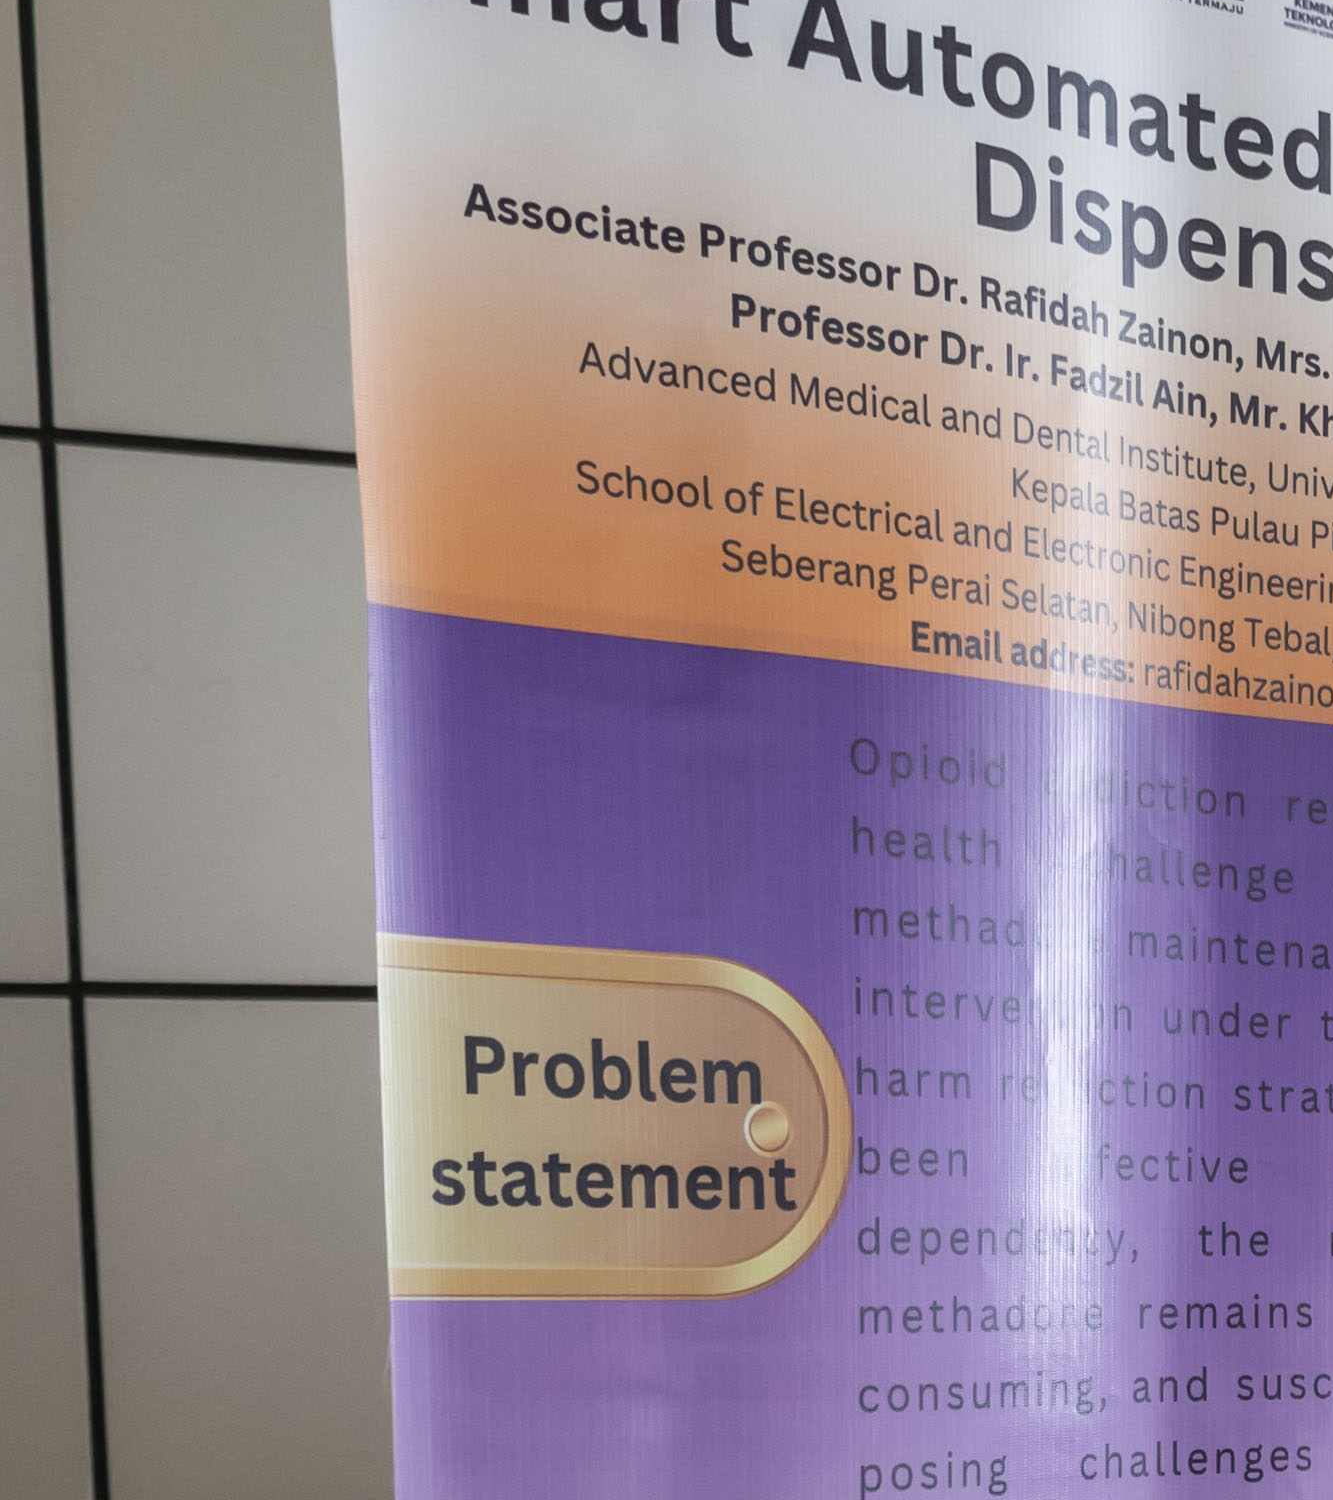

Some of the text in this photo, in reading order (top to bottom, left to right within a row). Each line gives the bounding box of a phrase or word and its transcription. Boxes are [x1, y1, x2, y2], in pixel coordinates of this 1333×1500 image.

[464, 184, 684, 253] Associate
[701, 223, 900, 290] Professor
[914, 263, 967, 304] Dr.
[981, 277, 1107, 335] Rafidah
[1120, 311, 1243, 372] Zainon,
[1257, 338, 1329, 378] Mrs.
[733, 294, 928, 358] Professor
[942, 331, 992, 371] Dr.
[1007, 344, 1038, 381] Ir.
[1052, 354, 1142, 405] Fadzil
[1153, 380, 1216, 427] Ain,
[1231, 393, 1286, 430] Mr.
[579, 342, 775, 401] Advanced
[791, 374, 931, 427] Medical
[942, 407, 1000, 439] and
[1014, 413, 1107, 460] Dental
[1122, 438, 1255, 494] Institute,
[1013, 468, 1107, 514] Kepala
[1121, 491, 1199, 532] Batas
[1212, 507, 1298, 545] Pulau
[912, 621, 1001, 662] Email
[1012, 639, 1133, 680] address:
[464, 1035, 762, 1105] Problem
[432, 1151, 797, 1211] statement
[860, 1371, 1107, 1415] consuming,
[1132, 1367, 1208, 1402] and
[1080, 1440, 1312, 1483] challenges
